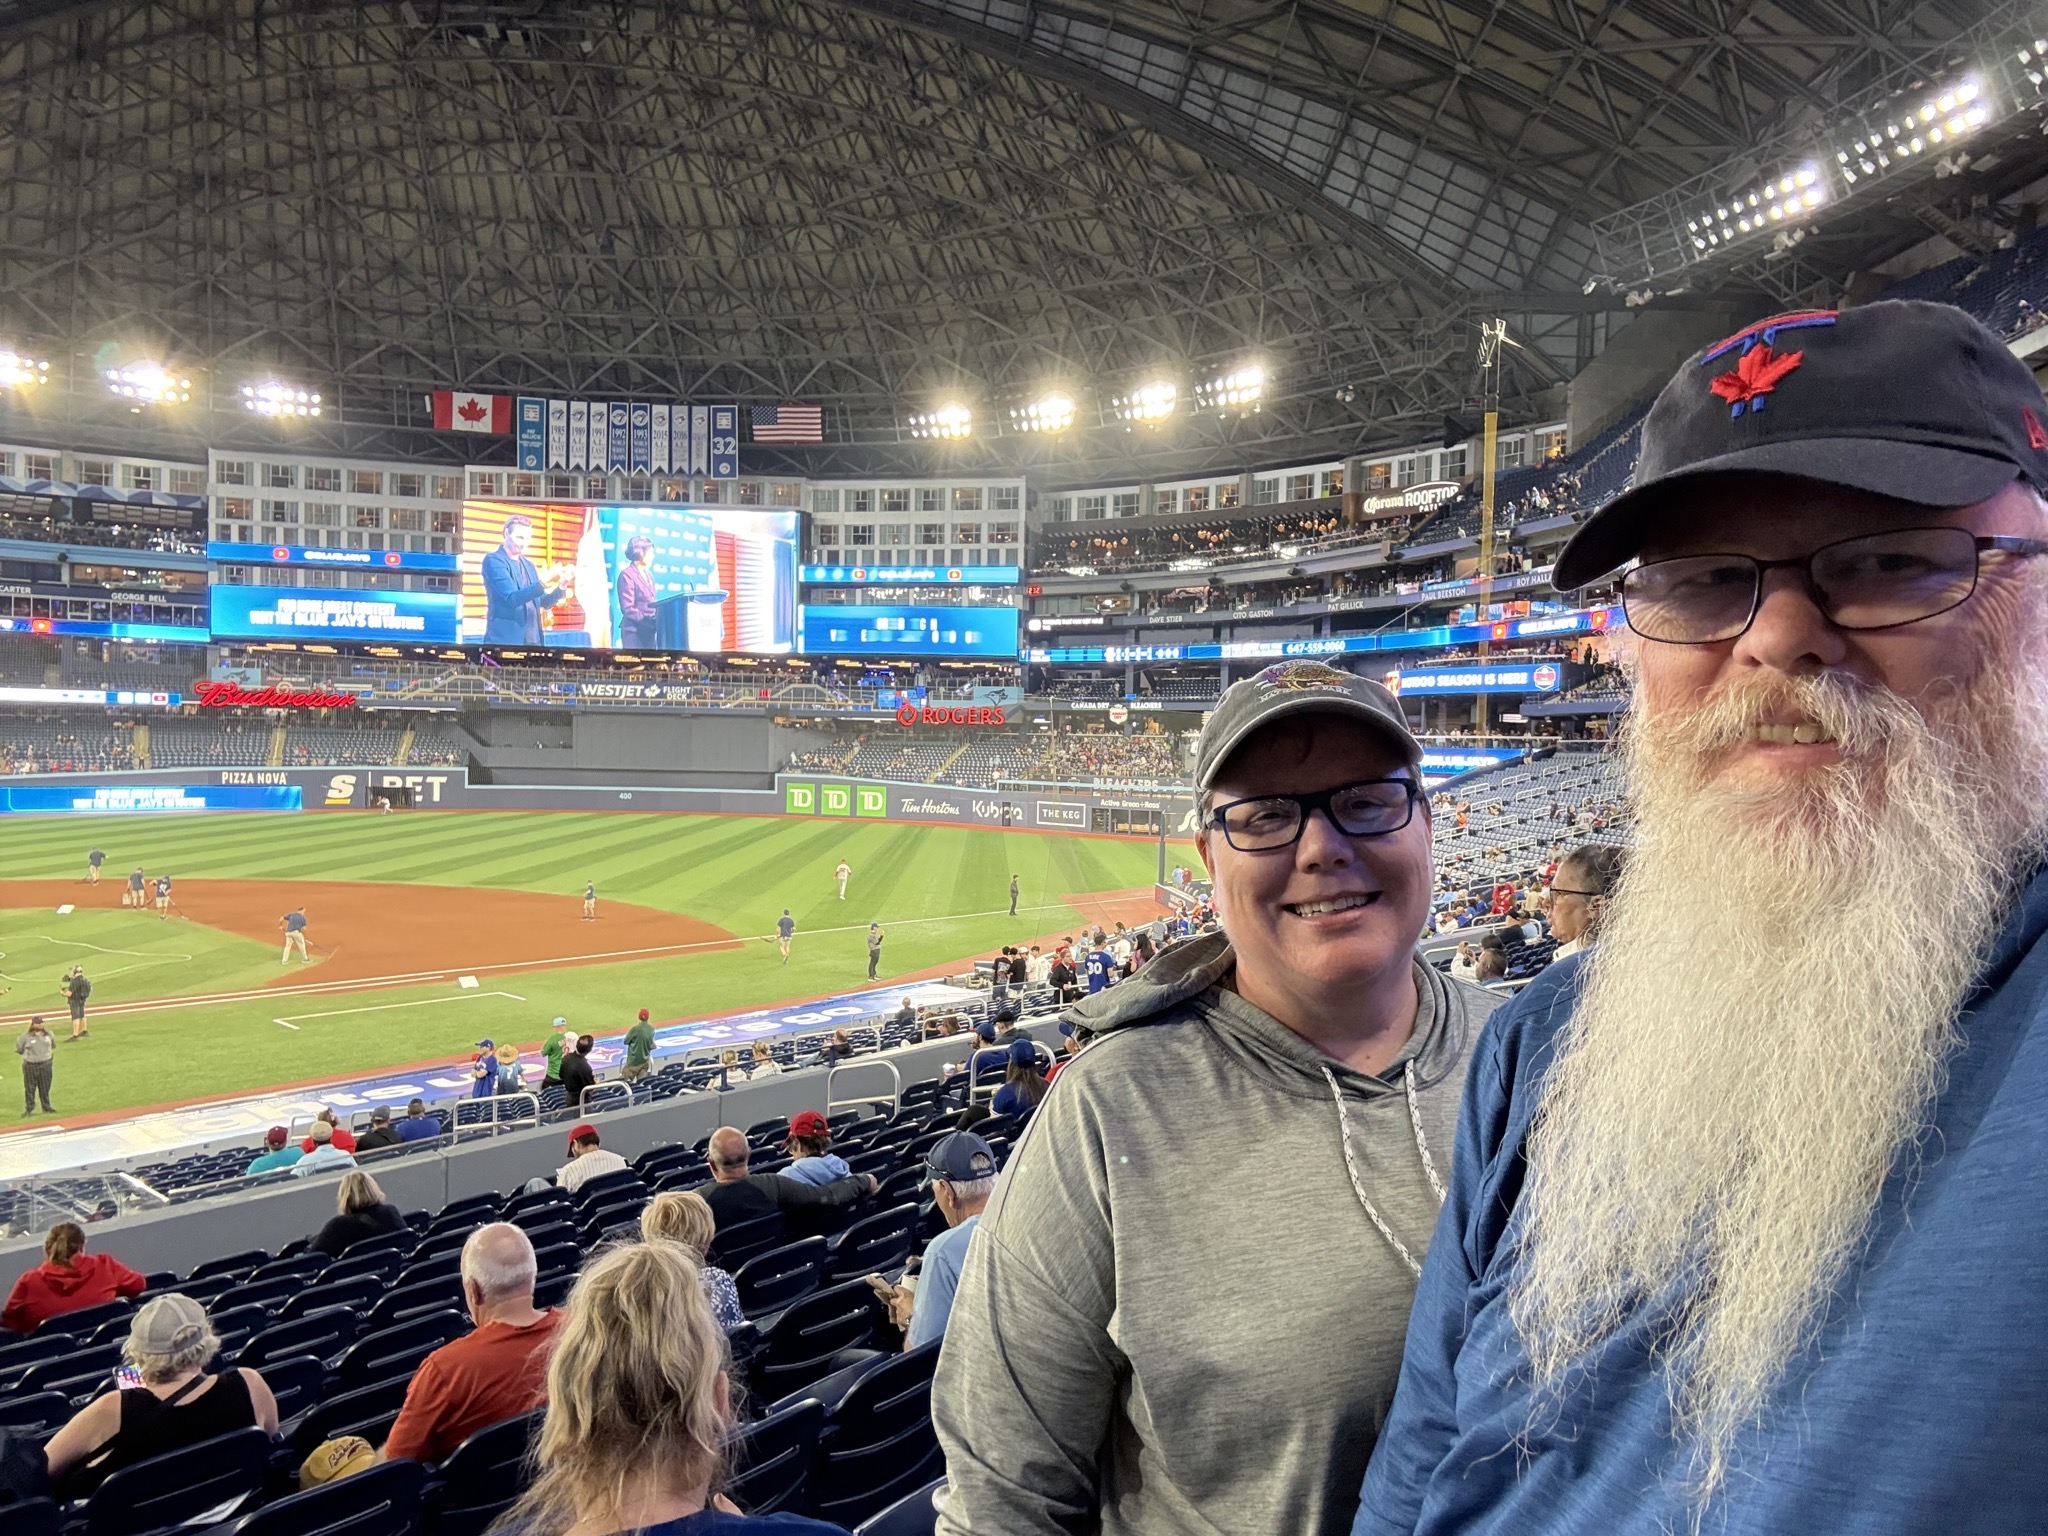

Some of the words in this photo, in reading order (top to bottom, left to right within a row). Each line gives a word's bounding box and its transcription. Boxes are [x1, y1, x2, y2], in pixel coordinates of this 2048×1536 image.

[551, 424, 565, 435] 1985
[592, 427, 605, 438] 1991
[612, 428, 626, 439] 1992
[633, 429, 648, 439] 1993
[653, 430, 668, 440] 2015
[673, 430, 688, 440] 2016
[713, 436, 736, 455] 32
[1363, 496, 1404, 514] Corona
[1404, 486, 1460, 508] ROOFTOP
[1516, 577, 1530, 587] ROY
[1531, 573, 1552, 585] HALLA
[111, 592, 145, 602] GEORGE
[149, 594, 167, 603] BELL
[1421, 592, 1436, 601] PAUL
[1438, 588, 1466, 599] BEESTON
[1327, 603, 1340, 612] PAT
[1340, 601, 1364, 610] GILLICK
[294, 612, 330, 627] BLUE
[331, 612, 367, 628] JAYS
[1149, 616, 1164, 624] DAVE
[1166, 615, 1183, 623] STIEB
[1233, 611, 1247, 620] CITO
[1249, 609, 1274, 619] GASTON
[1287, 641, 1346, 654] 647-559-0060
[1437, 674, 1482, 687] SEASON
[1484, 673, 1496, 685] IS
[1497, 672, 1528, 685] HERE
[194, 681, 356, 708] Budweiser
[581, 683, 645, 700] WESTJET
[663, 685, 691, 694] FLIGHT
[1071, 702, 1097, 710] CANADA
[922, 706, 1005, 725] ROGERS
[222, 771, 254, 785] PIZZA
[257, 772, 287, 785] NOVA
[619, 792, 632, 800] 400
[789, 788, 813, 808] TD
[824, 790, 848, 809] TD
[859, 791, 884, 811] TD
[900, 798, 921, 814] Tim
[921, 799, 960, 815] Hortons
[1100, 799, 1120, 807] Active
[1042, 808, 1060, 818] THE
[1063, 810, 1080, 819] KEG
[1087, 961, 1103, 975] 30
[654, 1021, 783, 1049] et's
[781, 1005, 864, 1026] go
